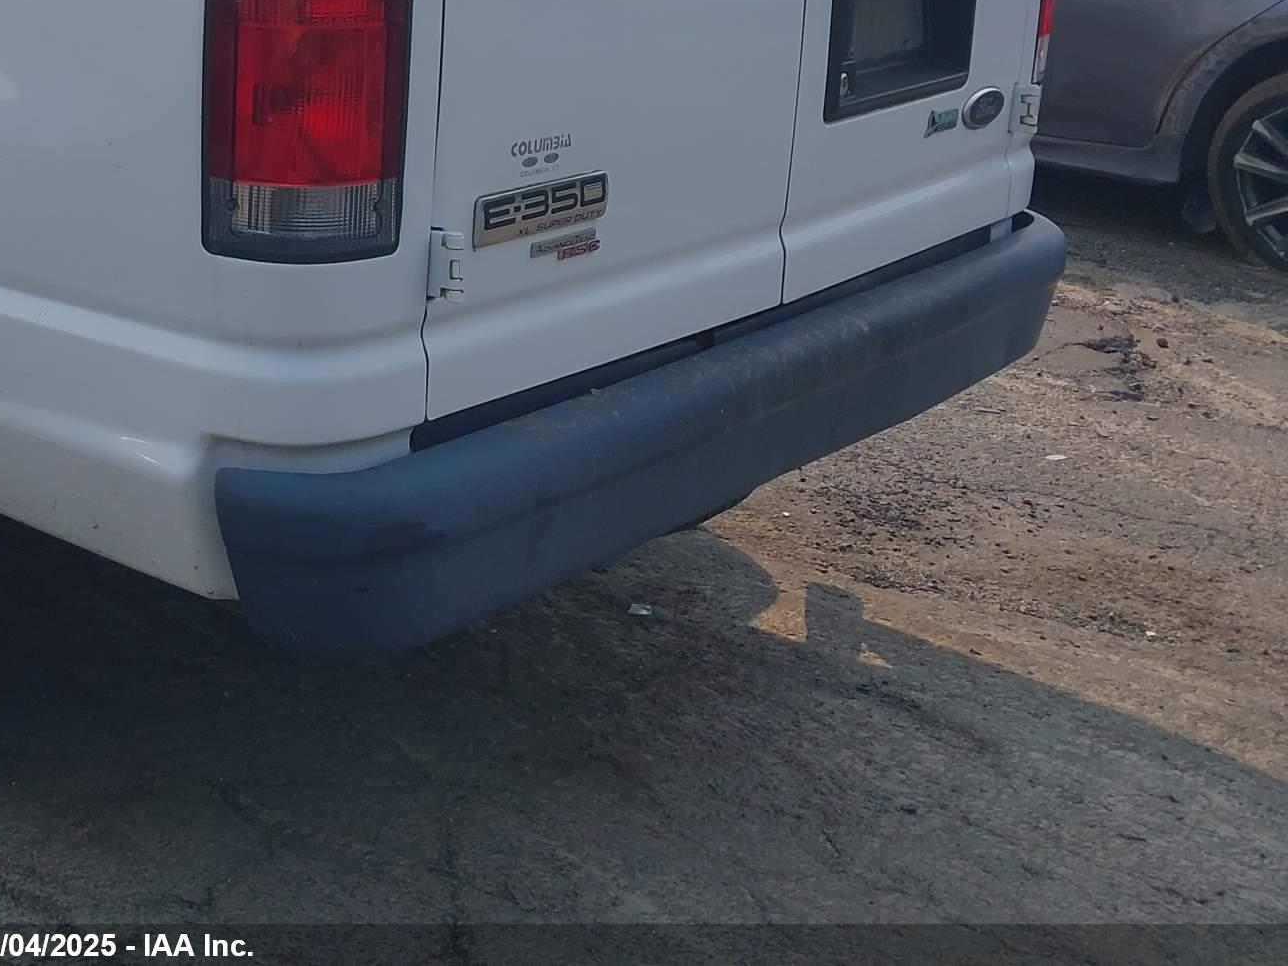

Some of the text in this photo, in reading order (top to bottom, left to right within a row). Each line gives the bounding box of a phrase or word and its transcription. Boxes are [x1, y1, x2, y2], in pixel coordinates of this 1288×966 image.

[511, 134, 572, 157] COLUMBIA
[536, 216, 573, 232] SUPER
[574, 208, 603, 224] DUTY
